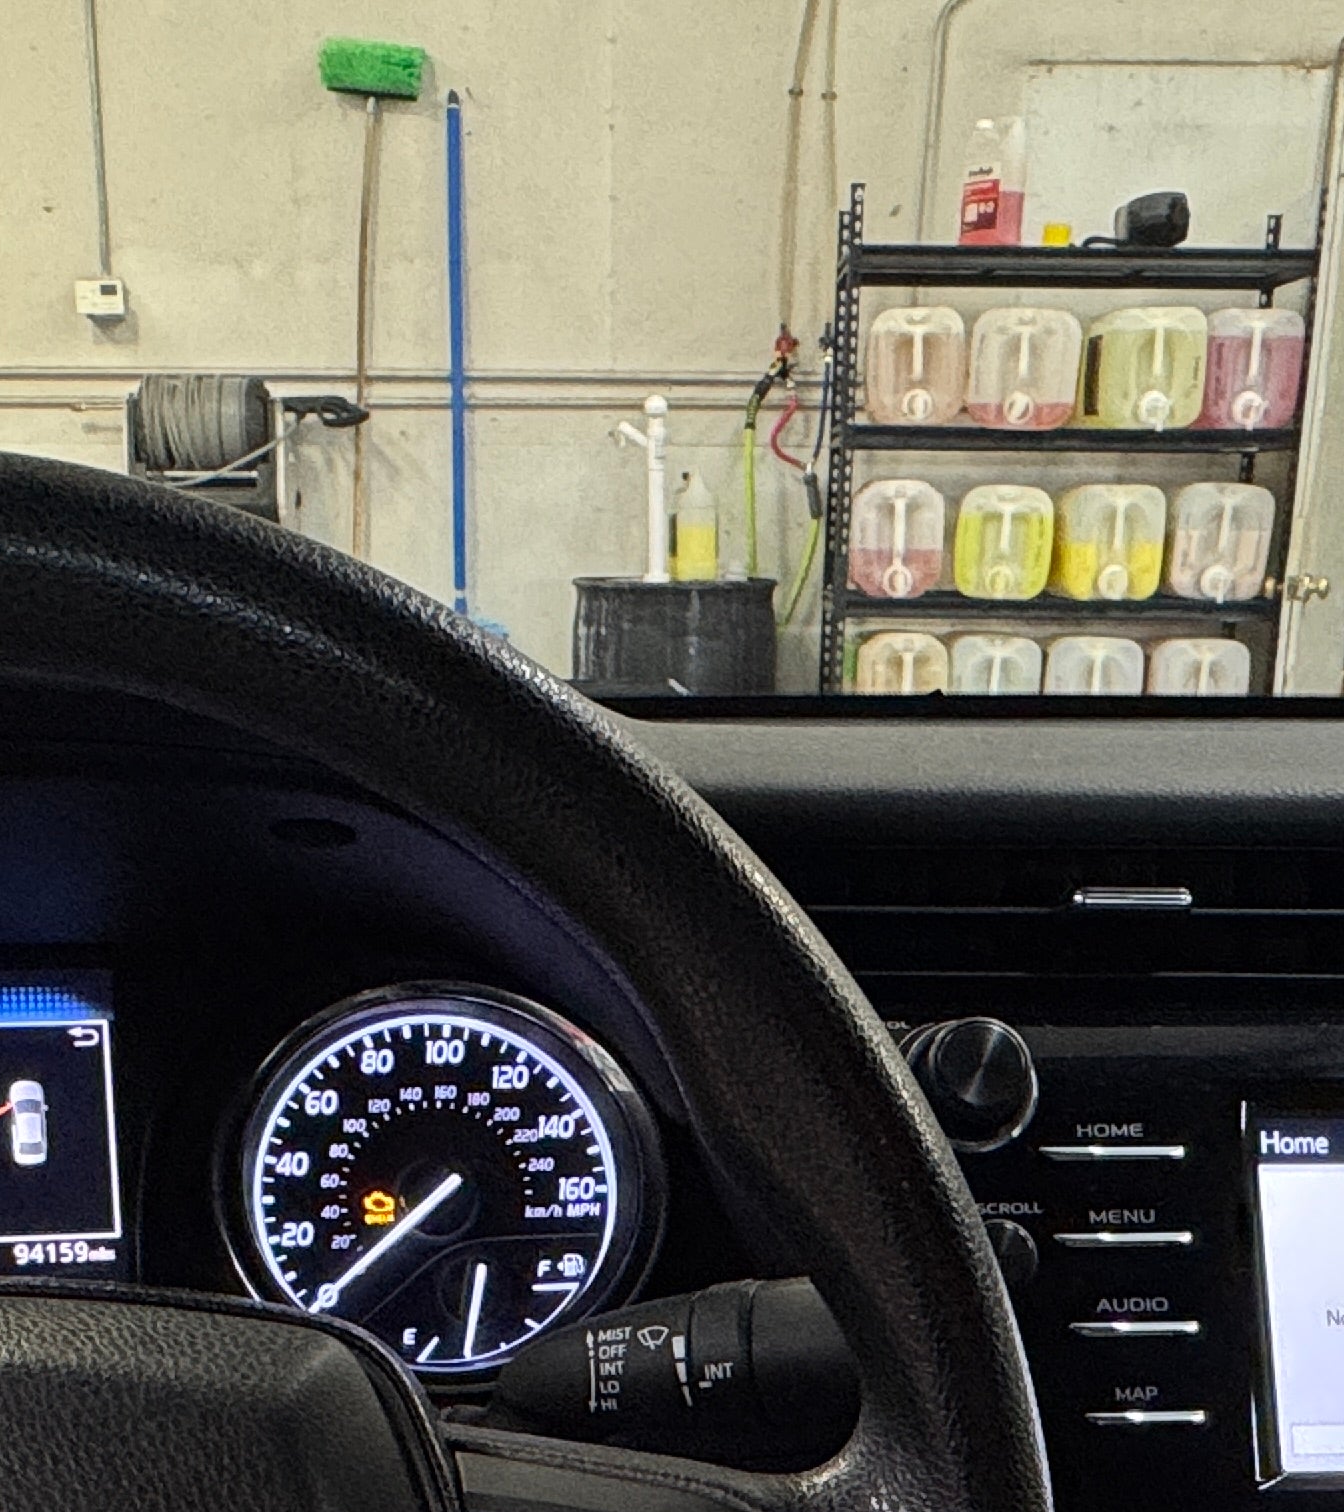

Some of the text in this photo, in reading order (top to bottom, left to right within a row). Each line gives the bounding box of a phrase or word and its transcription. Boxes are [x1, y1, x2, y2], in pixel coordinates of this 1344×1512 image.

[360, 1048, 394, 1075] 80
[425, 1040, 465, 1066] 100
[492, 1065, 530, 1090] 120
[399, 1086, 423, 1101] 140
[304, 1089, 339, 1116] 60
[367, 1098, 392, 1114] 120
[493, 1107, 521, 1122] 200
[342, 1118, 367, 1133] 100
[538, 1114, 574, 1140] 140
[1076, 1122, 1144, 1139] HOME
[513, 1128, 538, 1143] 220
[1259, 1130, 1330, 1156] Home
[329, 1143, 349, 1159] 80
[276, 1151, 309, 1177] 40
[527, 1157, 555, 1172] 240
[320, 1173, 340, 1188] 60
[558, 1176, 596, 1201] 160
[320, 1205, 340, 1219] 40
[524, 1202, 601, 1219] km/h MPH
[1088, 1208, 1156, 1225] MENU
[281, 1221, 315, 1248] 20
[331, 1235, 351, 1250] 20
[12, 1239, 89, 1266] 94159
[537, 1260, 552, 1278] F
[1096, 1297, 1169, 1313] AUDIO
[403, 1328, 417, 1346] E
[598, 1326, 633, 1343] MIST
[599, 1344, 628, 1359] OFF
[599, 1362, 625, 1376] INT
[705, 1362, 734, 1381] INT
[599, 1380, 620, 1394] LO
[1114, 1386, 1159, 1401] MAP
[600, 1398, 618, 1411] HI
